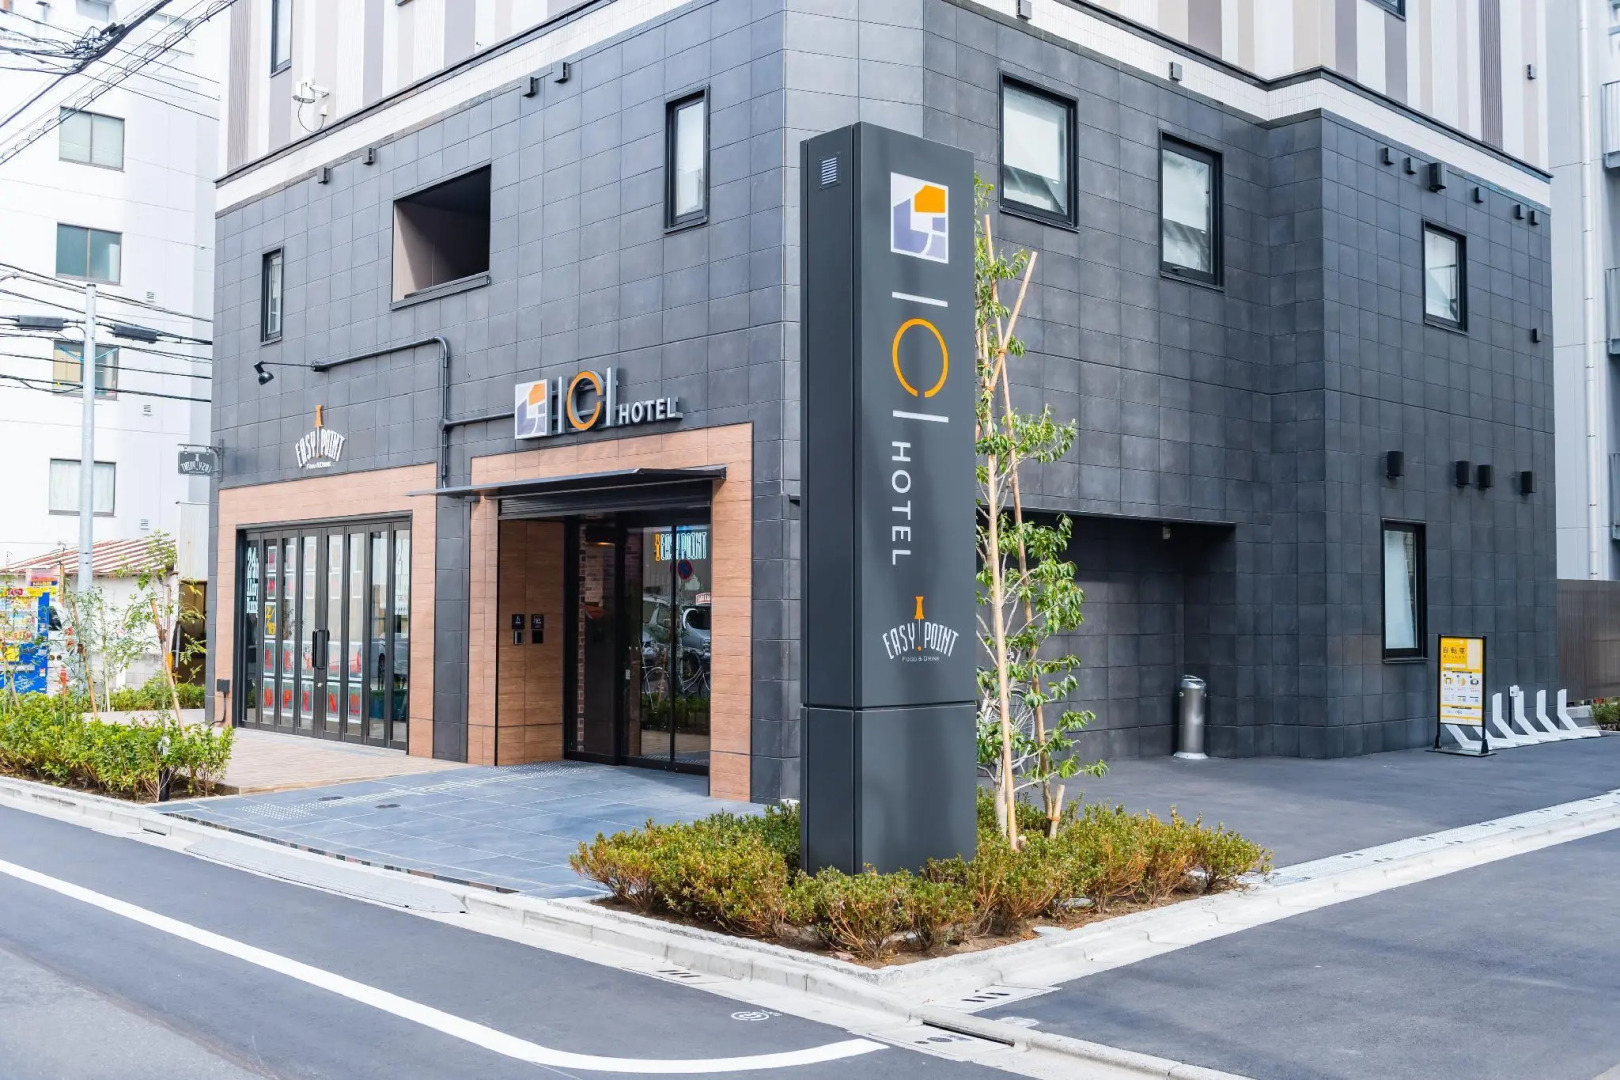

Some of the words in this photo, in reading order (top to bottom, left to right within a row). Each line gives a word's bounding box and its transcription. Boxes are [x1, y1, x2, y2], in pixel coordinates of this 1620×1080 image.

[619, 397, 676, 425] HOTEL
[295, 430, 316, 468] EASY
[320, 429, 346, 462] POINT
[891, 441, 911, 565] HOTEL
[681, 532, 707, 560] POINT
[882, 622, 915, 660] EASY
[924, 621, 959, 657] POINT
